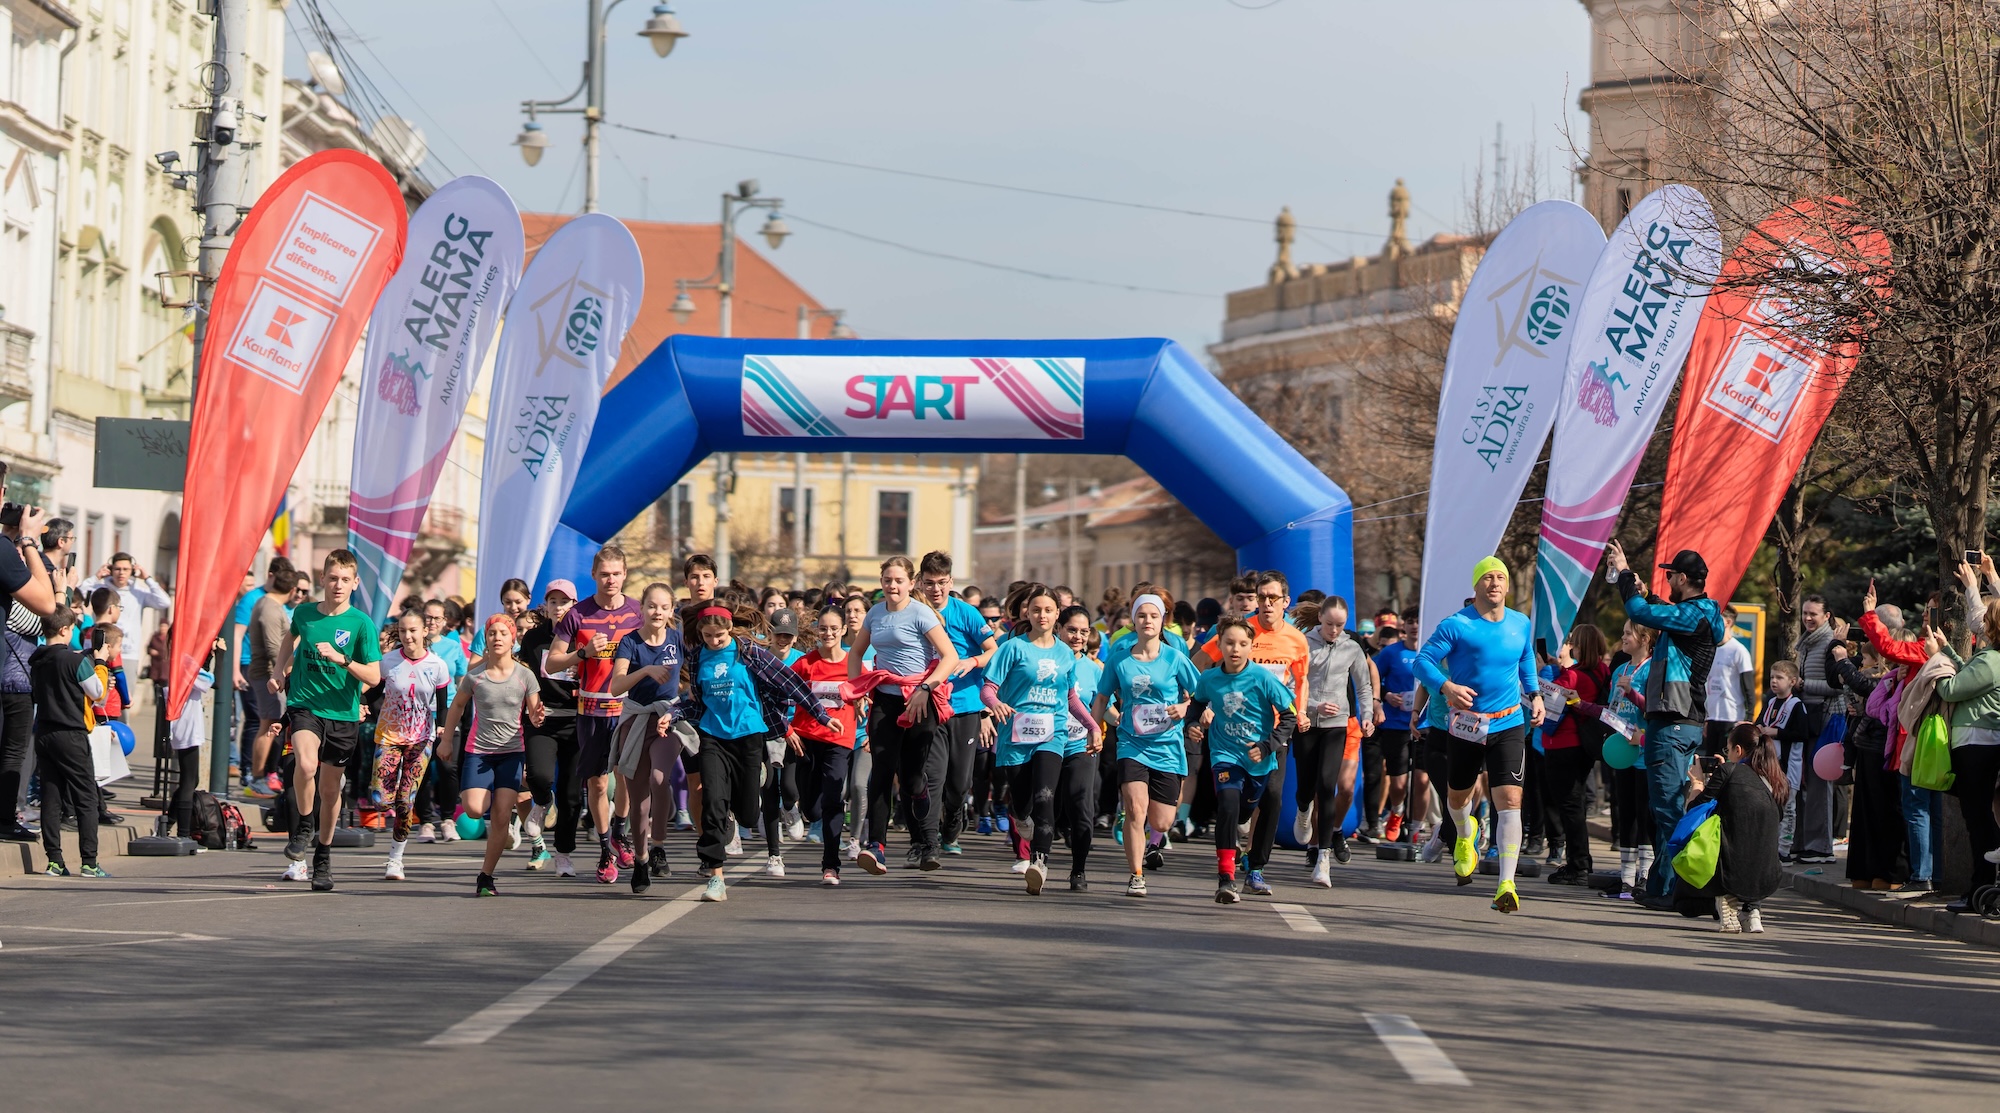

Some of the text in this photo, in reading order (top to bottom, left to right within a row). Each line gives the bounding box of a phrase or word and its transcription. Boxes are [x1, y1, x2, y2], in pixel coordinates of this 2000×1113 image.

[293, 236, 317, 255] face
[300, 222, 357, 258] Implicarea
[404, 212, 469, 345] ALERG
[425, 231, 494, 351] MAMA
[1605, 221, 1670, 355] ALERG
[1625, 240, 1693, 362] MAMA
[241, 335, 303, 373] Kaufland
[1655, 319, 1677, 357] Târgu
[844, 374, 980, 421] START
[1462, 384, 1498, 445] CASA
[1720, 381, 1782, 423] Kaufland
[507, 395, 540, 454] CASA
[521, 394, 570, 481] ADRA
[546, 411, 577, 473] www.adra.ro
[1476, 383, 1529, 473] ADRA
[1504, 402, 1535, 464] www.adra.ro
[1027, 694, 1057, 705] MAMA
[1029, 685, 1058, 697] ALERG
[1538, 682, 1560, 693] PLOMA
[1022, 726, 1046, 736] 2533
[1067, 724, 1084, 734] 789
[1142, 716, 1168, 727] 2534
